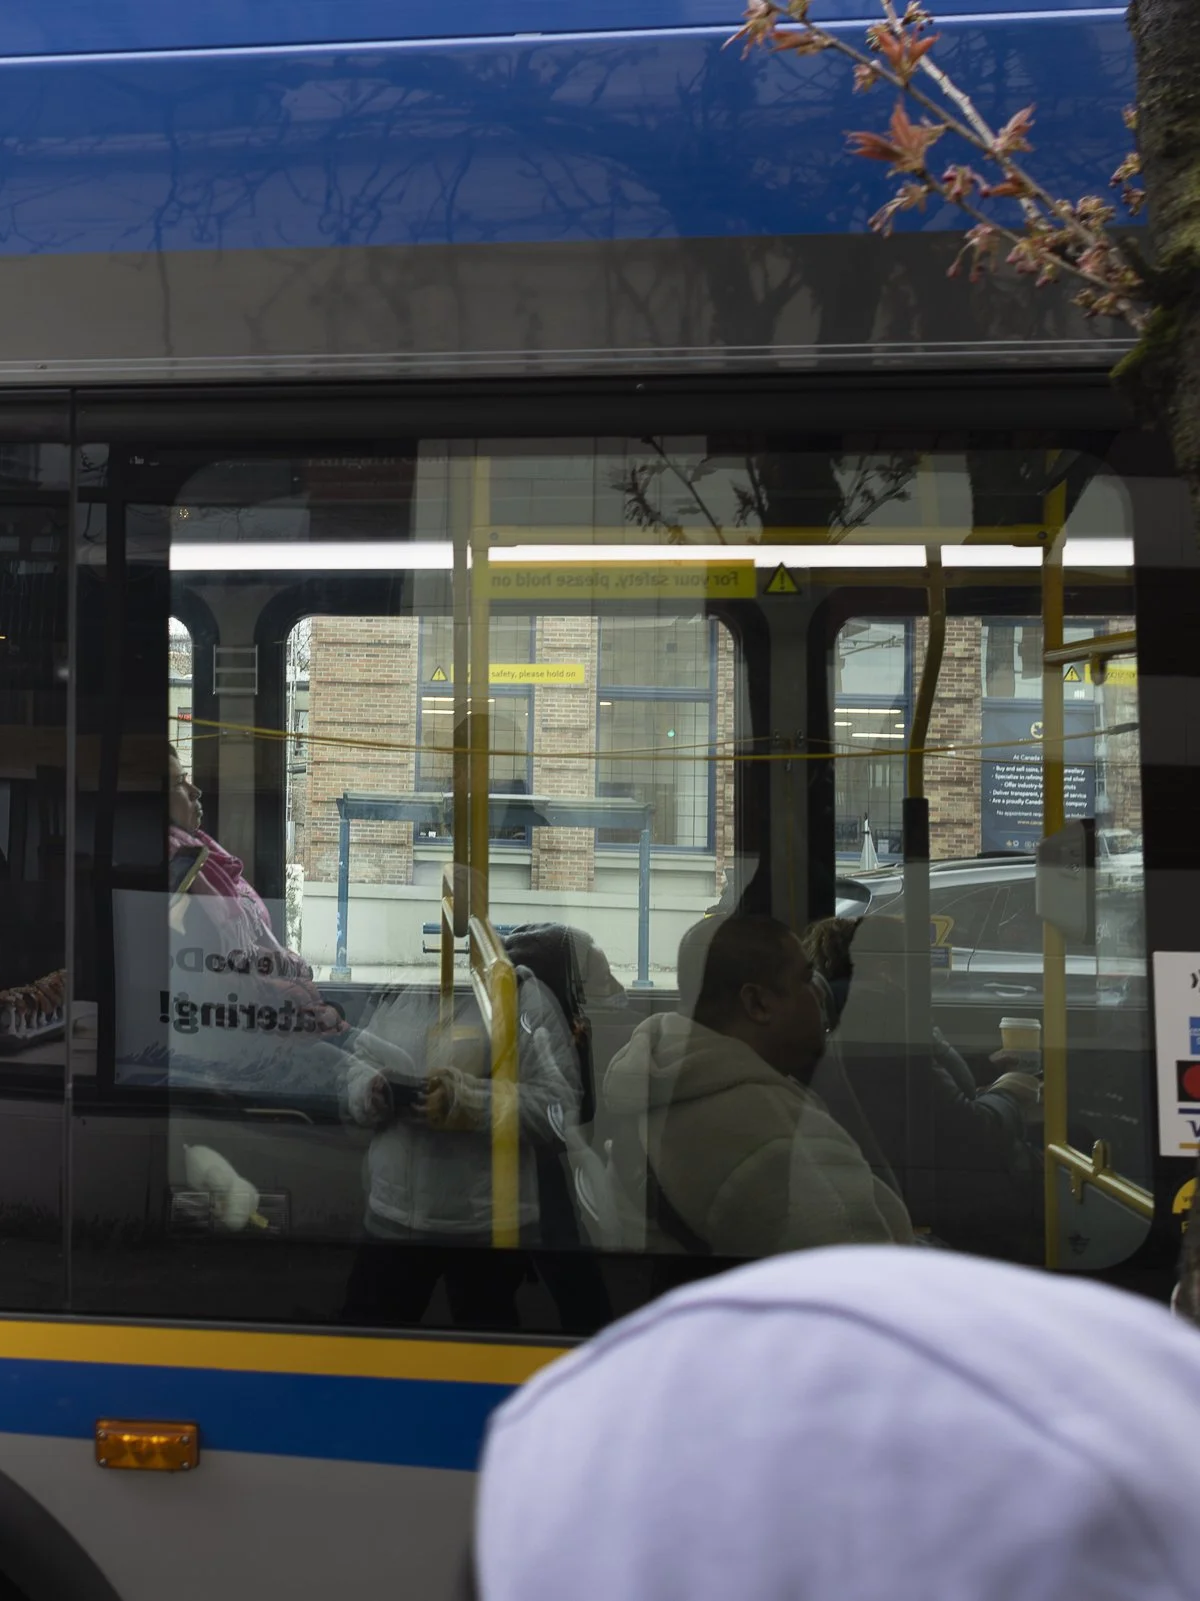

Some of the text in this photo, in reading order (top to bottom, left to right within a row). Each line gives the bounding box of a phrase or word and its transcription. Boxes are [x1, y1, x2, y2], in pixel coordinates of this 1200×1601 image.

[491, 670, 517, 680] safety,
[518, 670, 545, 680] please
[546, 669, 564, 678] hold
